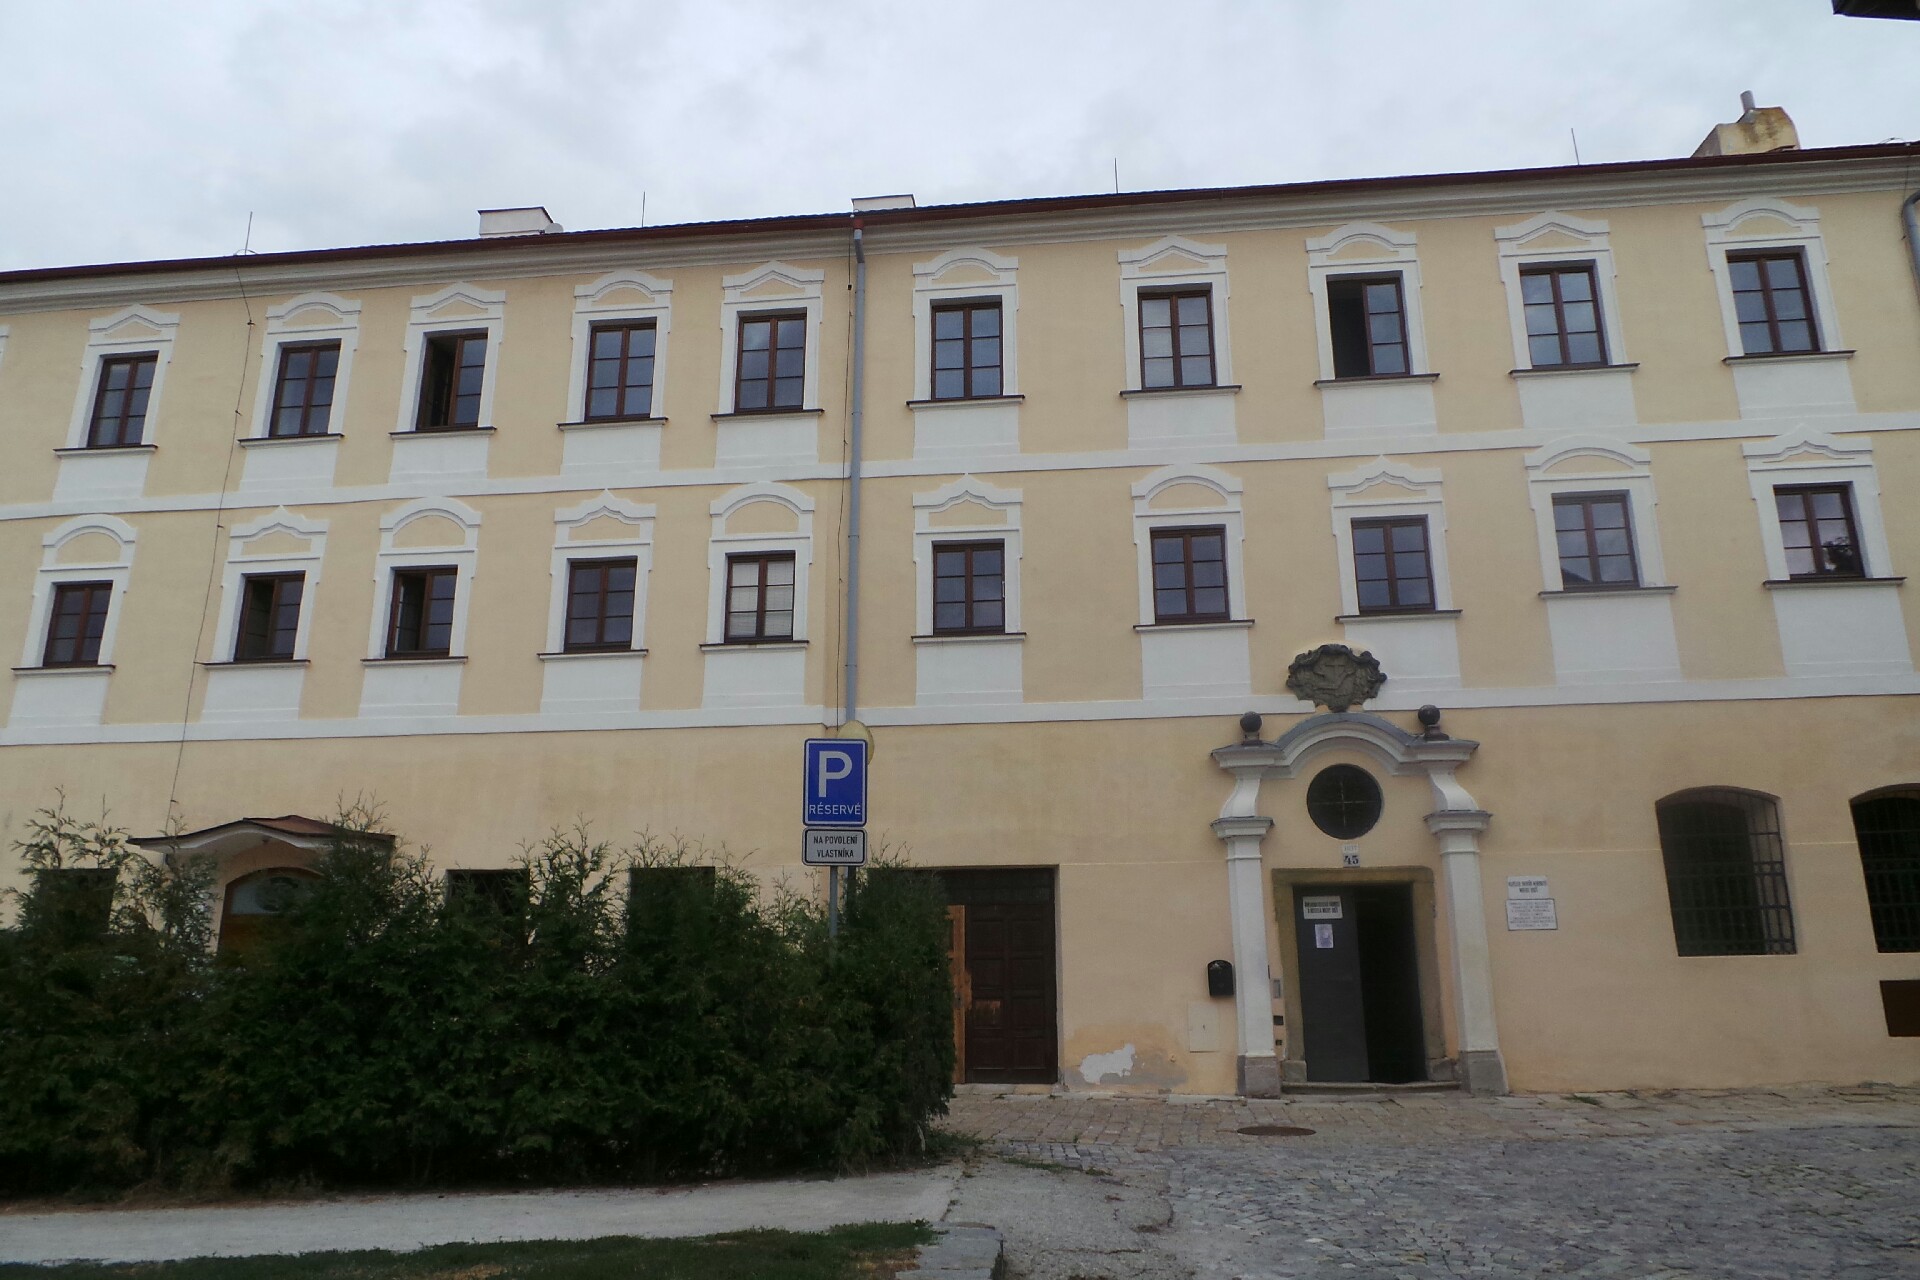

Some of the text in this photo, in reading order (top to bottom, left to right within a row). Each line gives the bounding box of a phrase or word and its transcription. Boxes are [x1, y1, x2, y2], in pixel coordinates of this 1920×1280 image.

[819, 751, 852, 797] P
[809, 801, 861, 815] RÉSERVÉ
[813, 834, 858, 845] NA POVOLENÍ
[817, 848, 854, 858] VLASTNÍKA
[1344, 855, 1359, 865] 45
